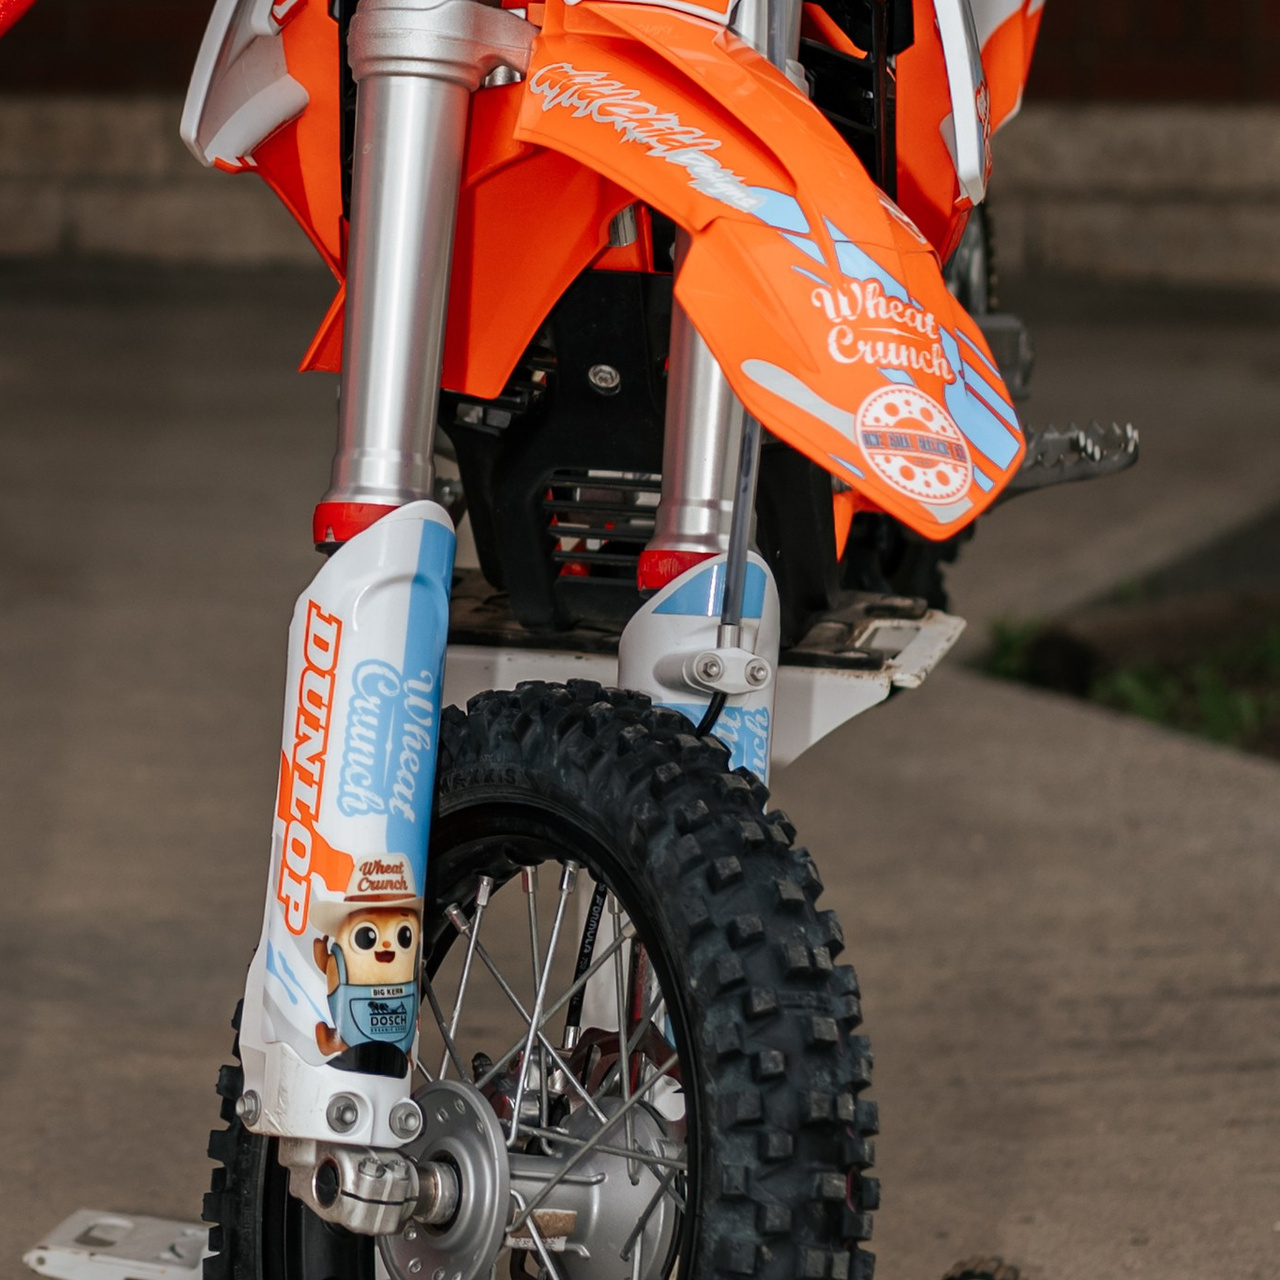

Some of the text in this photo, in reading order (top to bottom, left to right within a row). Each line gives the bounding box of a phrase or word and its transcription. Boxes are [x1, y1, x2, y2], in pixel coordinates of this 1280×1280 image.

[811, 282, 939, 339] Wheat
[827, 325, 953, 380] Crunch
[342, 661, 401, 816] Crunch
[392, 670, 433, 823] Wheat
[278, 599, 342, 935] DUNLOP
[357, 876, 408, 892] Crunch
[359, 859, 405, 876] Wheat
[583, 893, 603, 954] FORMULA
[373, 988, 385, 996] BIG
[370, 1015, 407, 1027] DOSCH
